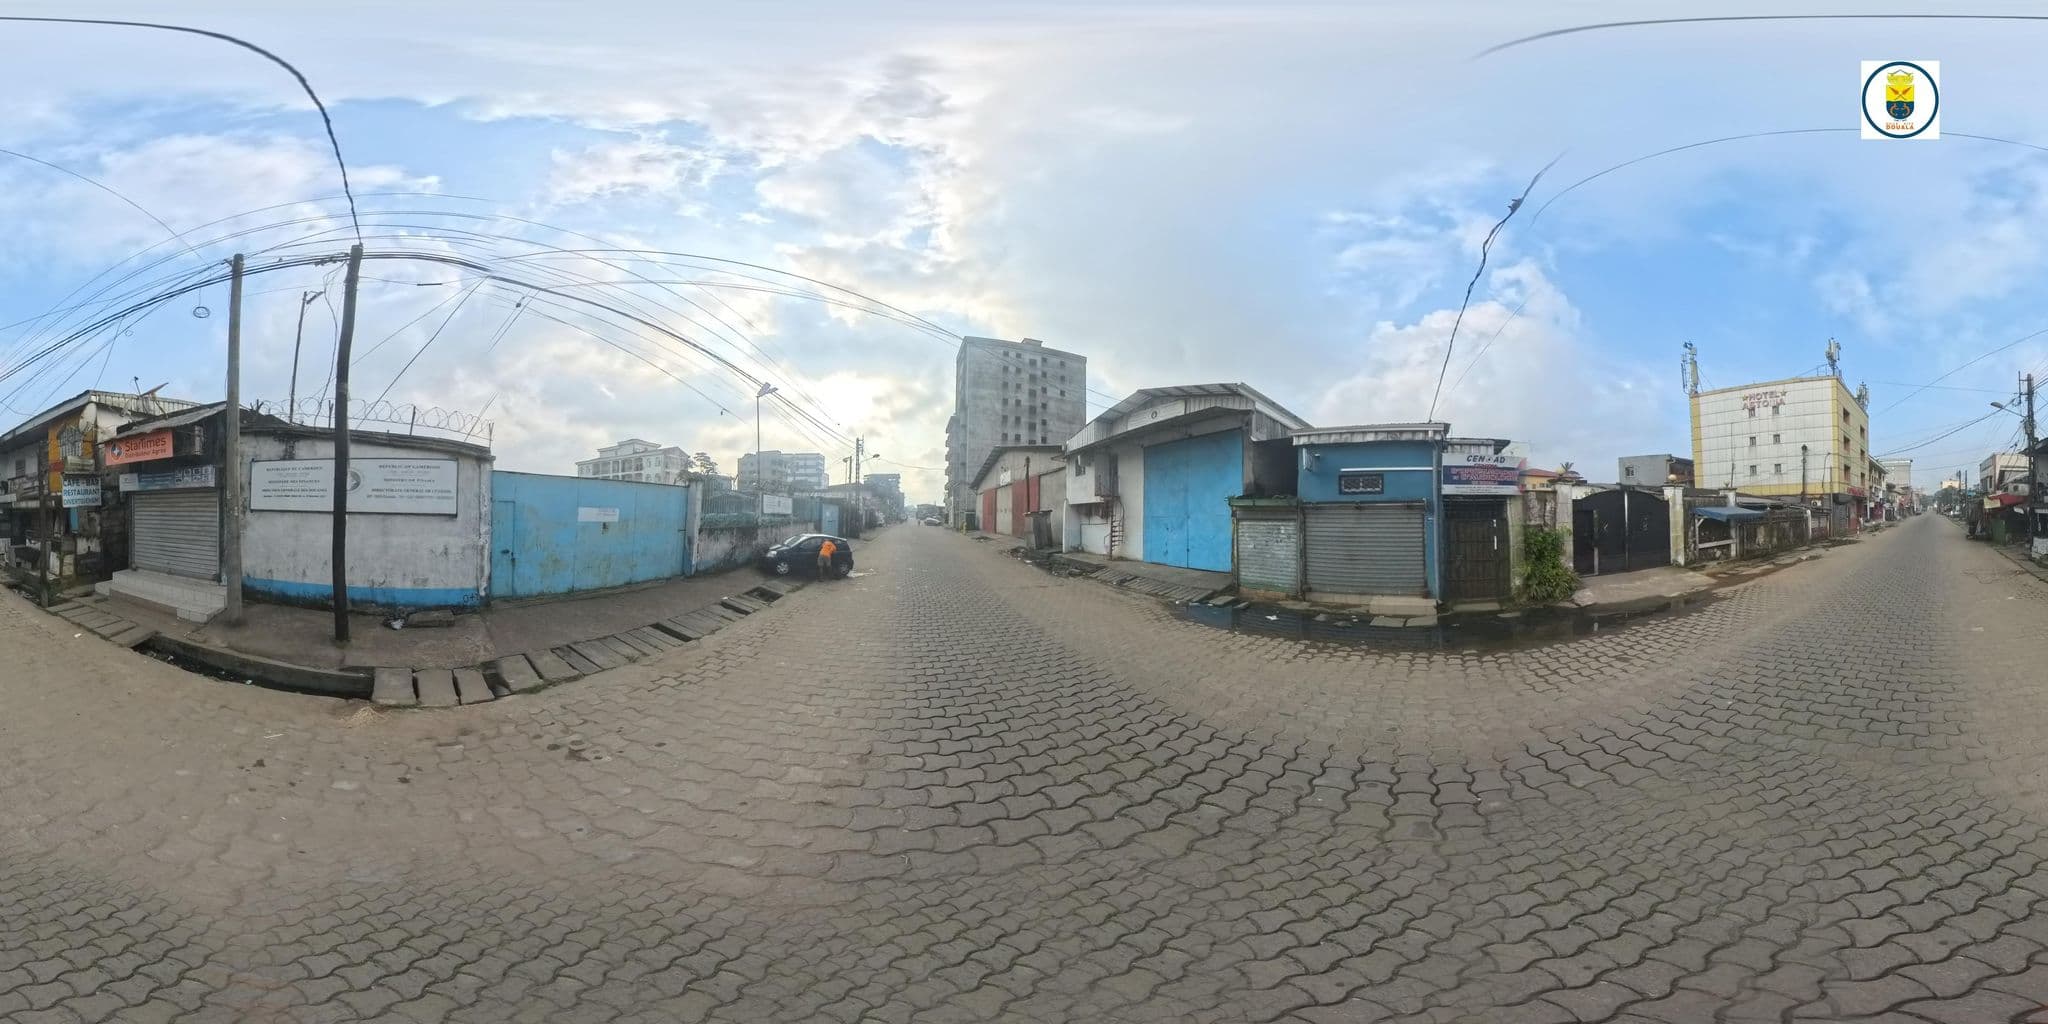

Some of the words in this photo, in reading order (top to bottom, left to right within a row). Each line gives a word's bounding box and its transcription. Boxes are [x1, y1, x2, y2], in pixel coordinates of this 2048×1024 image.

[1749, 391, 1780, 401] HOTEL
[125, 437, 166, 452] StarTimes
[64, 488, 100, 496] RESTAURANT
